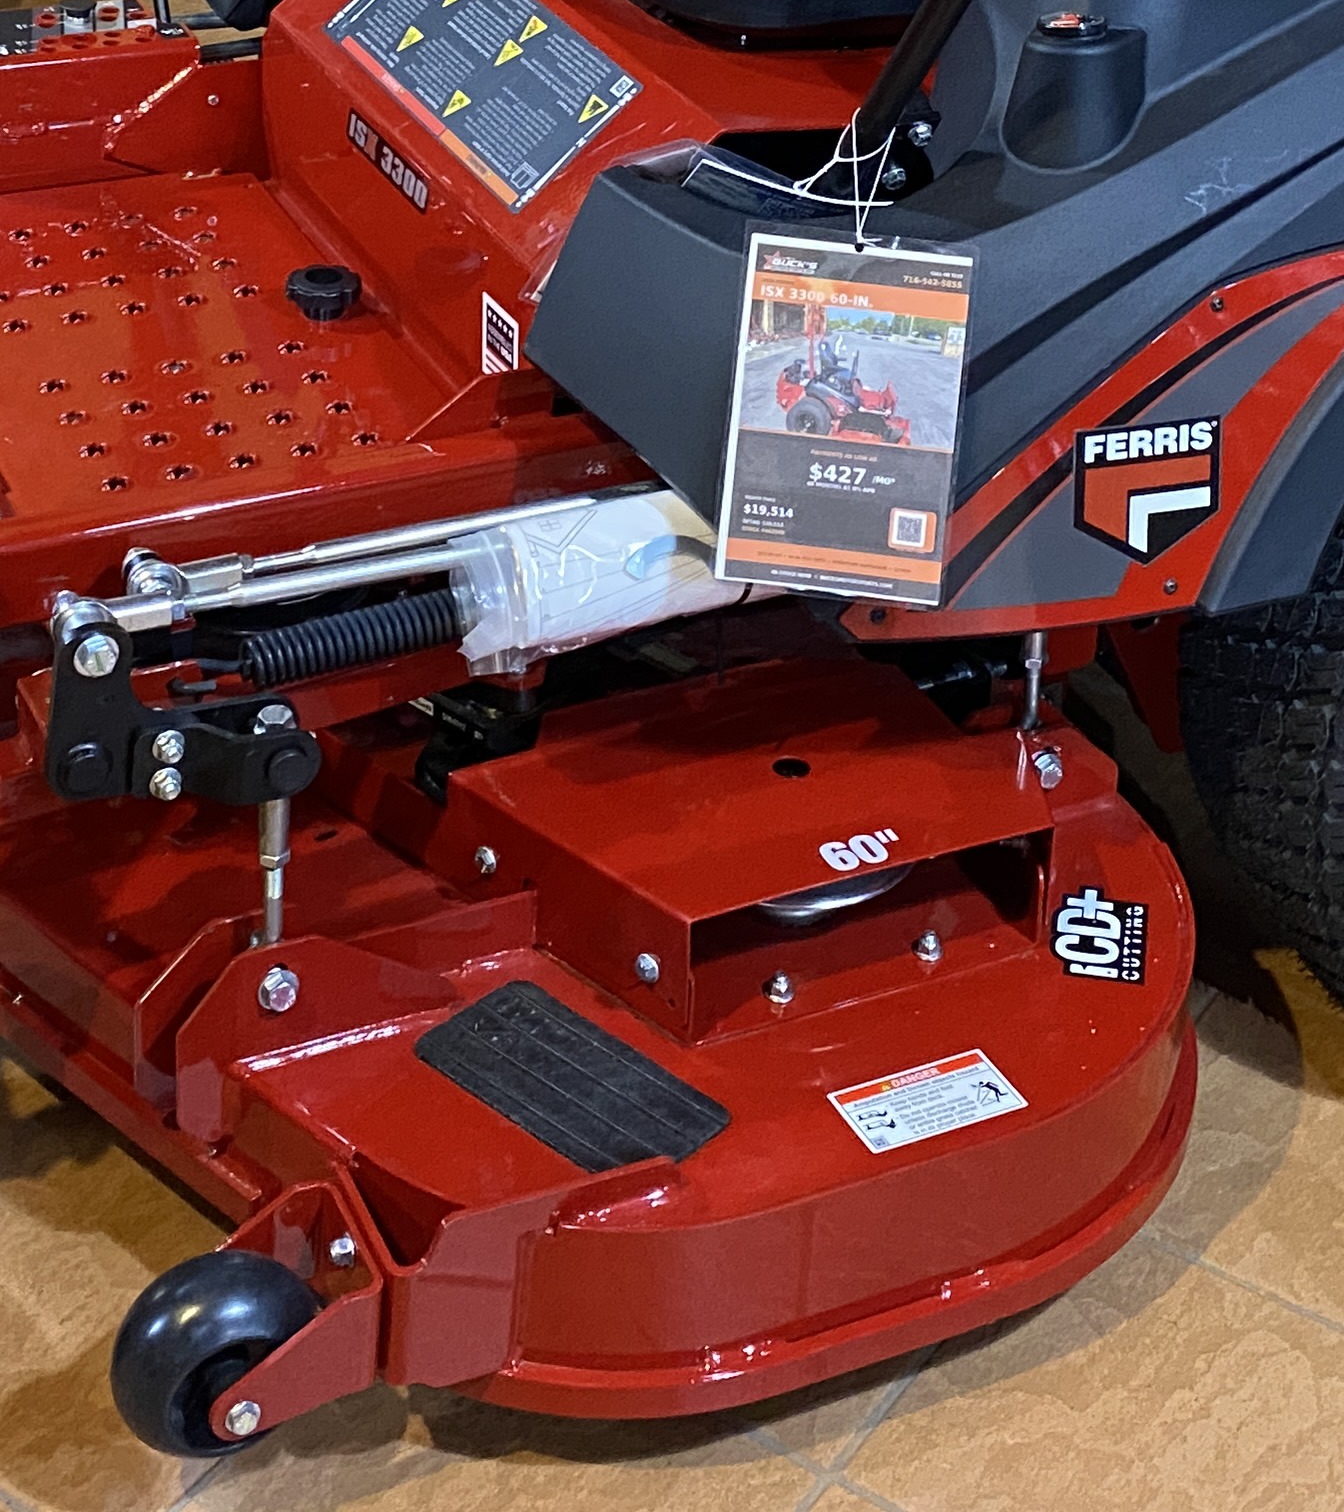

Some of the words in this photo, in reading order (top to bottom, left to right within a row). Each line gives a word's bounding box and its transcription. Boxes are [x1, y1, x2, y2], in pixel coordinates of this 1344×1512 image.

[348, 112, 379, 161] ISX
[380, 147, 428, 210] 3300
[761, 284, 785, 298] ISX
[789, 287, 825, 302] 3300
[830, 291, 874, 308] 60-IN.
[1084, 421, 1213, 464] FERRIS
[809, 462, 866, 485] $427
[743, 503, 794, 518] $19,514
[819, 828, 900, 872] 60"
[1121, 905, 1144, 981] CUTTING
[889, 1067, 940, 1087] DANGER
